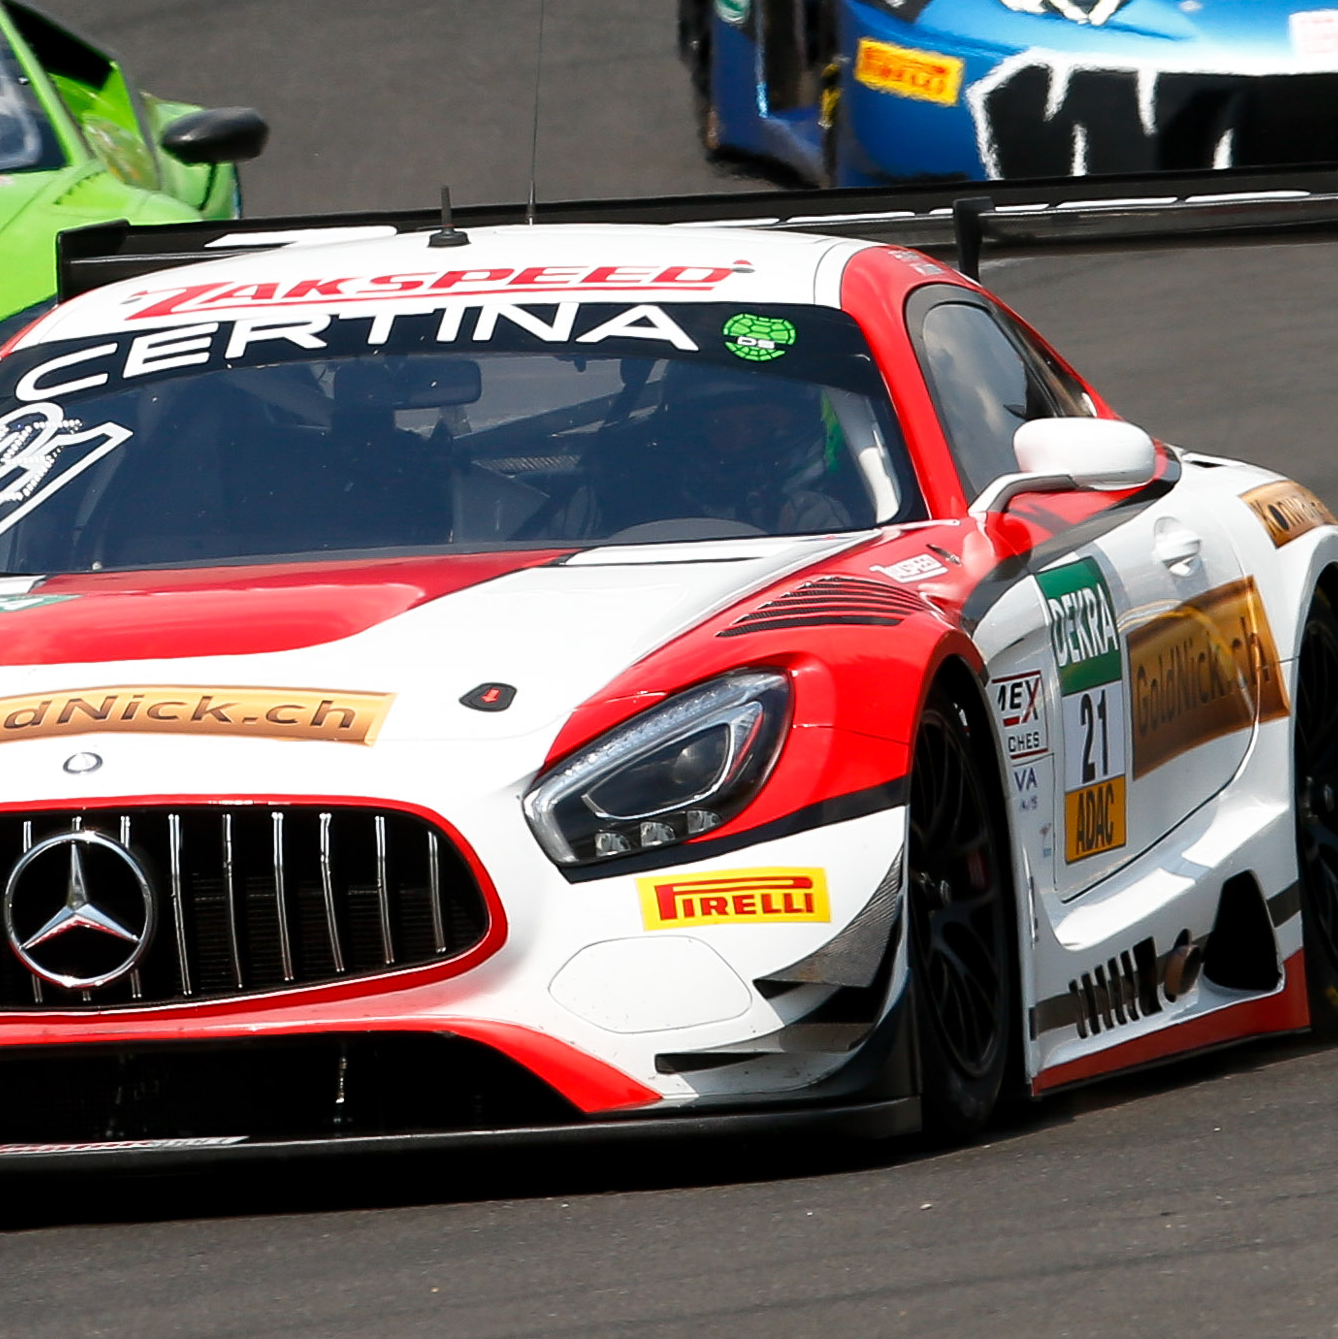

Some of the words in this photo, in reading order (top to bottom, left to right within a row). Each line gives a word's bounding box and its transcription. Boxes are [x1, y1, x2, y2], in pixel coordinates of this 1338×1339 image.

[124, 264, 739, 320] ZAKSPEED
[15, 301, 699, 403] CERTINA
[1048, 582, 1119, 667] DEKRA
[1080, 688, 1109, 784] 21
[1076, 783, 1115, 855] ADAC
[654, 875, 815, 921] PIRELLI
